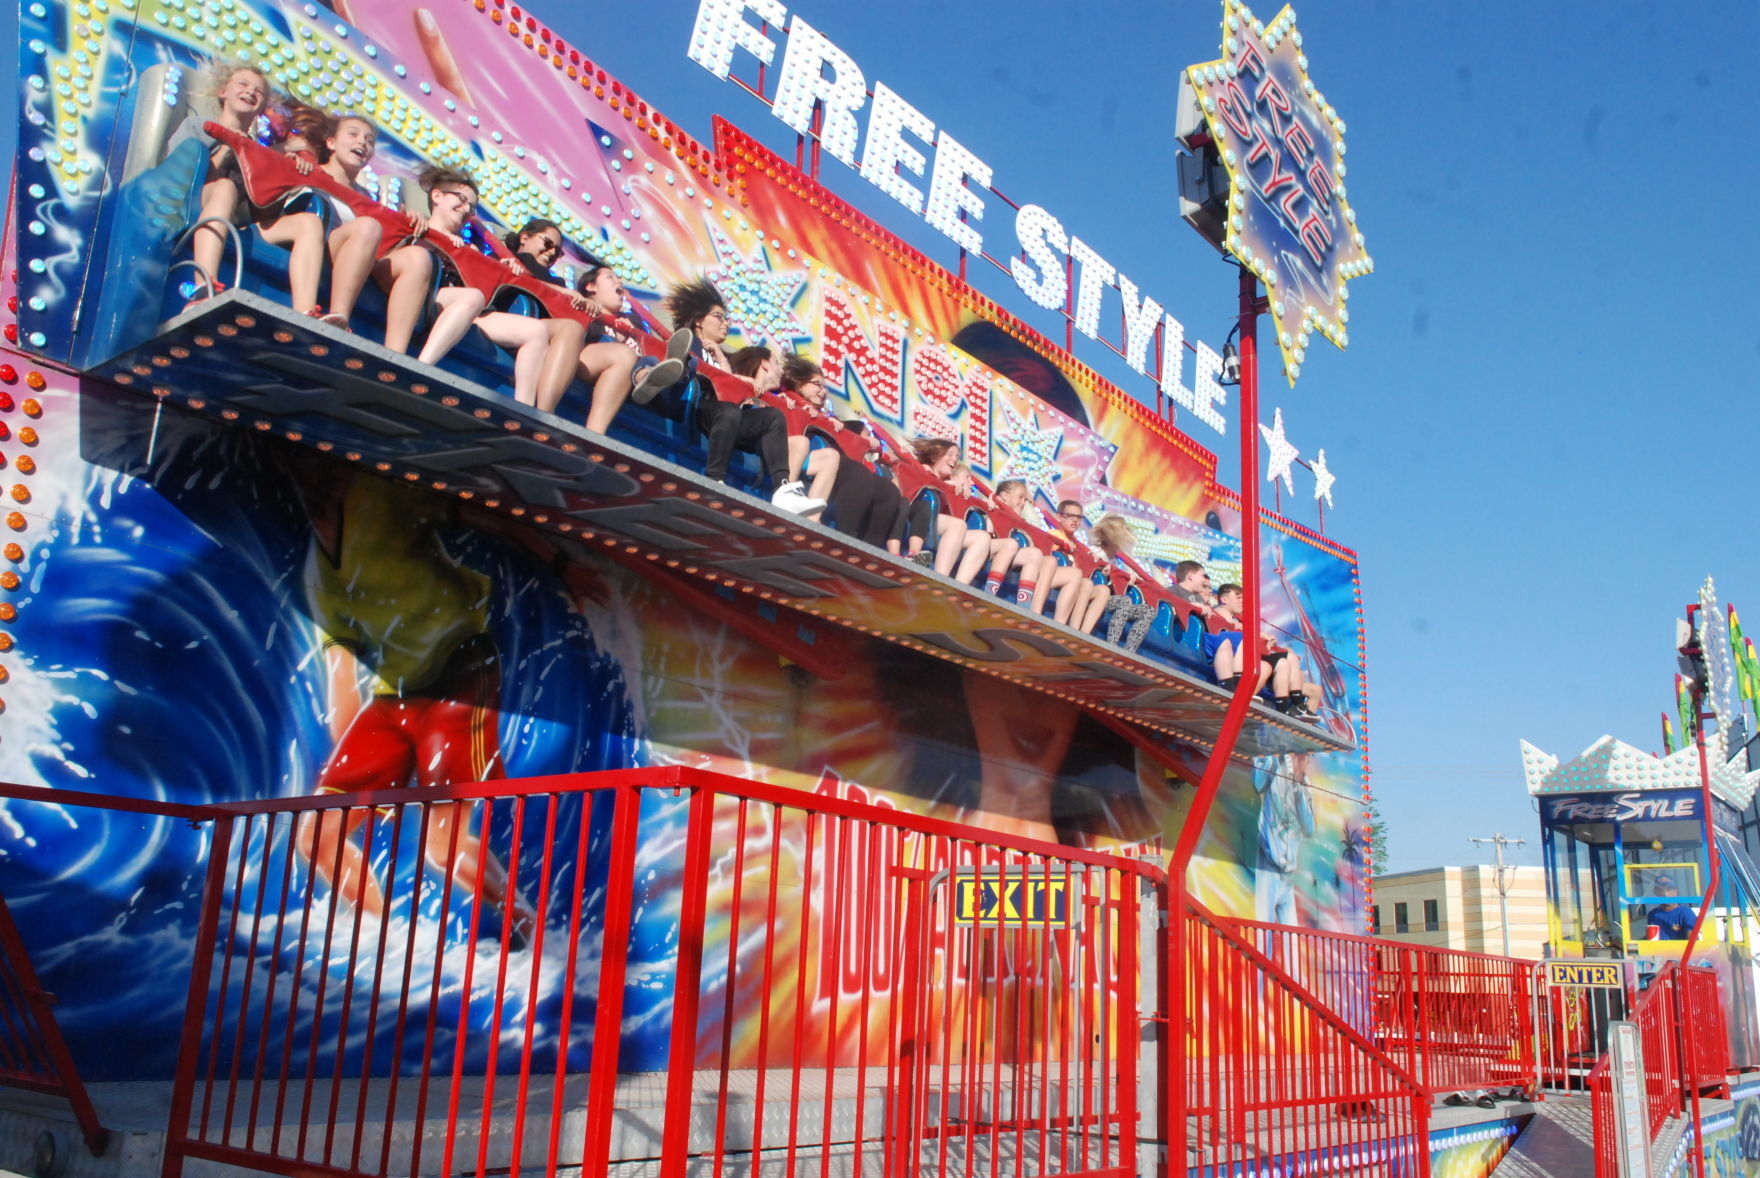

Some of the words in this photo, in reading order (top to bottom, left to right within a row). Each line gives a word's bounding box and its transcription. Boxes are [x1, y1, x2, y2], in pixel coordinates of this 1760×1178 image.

[1217, 80, 1334, 265] STYLE
[1236, 39, 1335, 208] FREE
[687, 0, 994, 258] FREE
[1010, 204, 1227, 436] STYLE
[961, 882, 1064, 919] EXIT
[1553, 965, 1618, 985] ENTER
